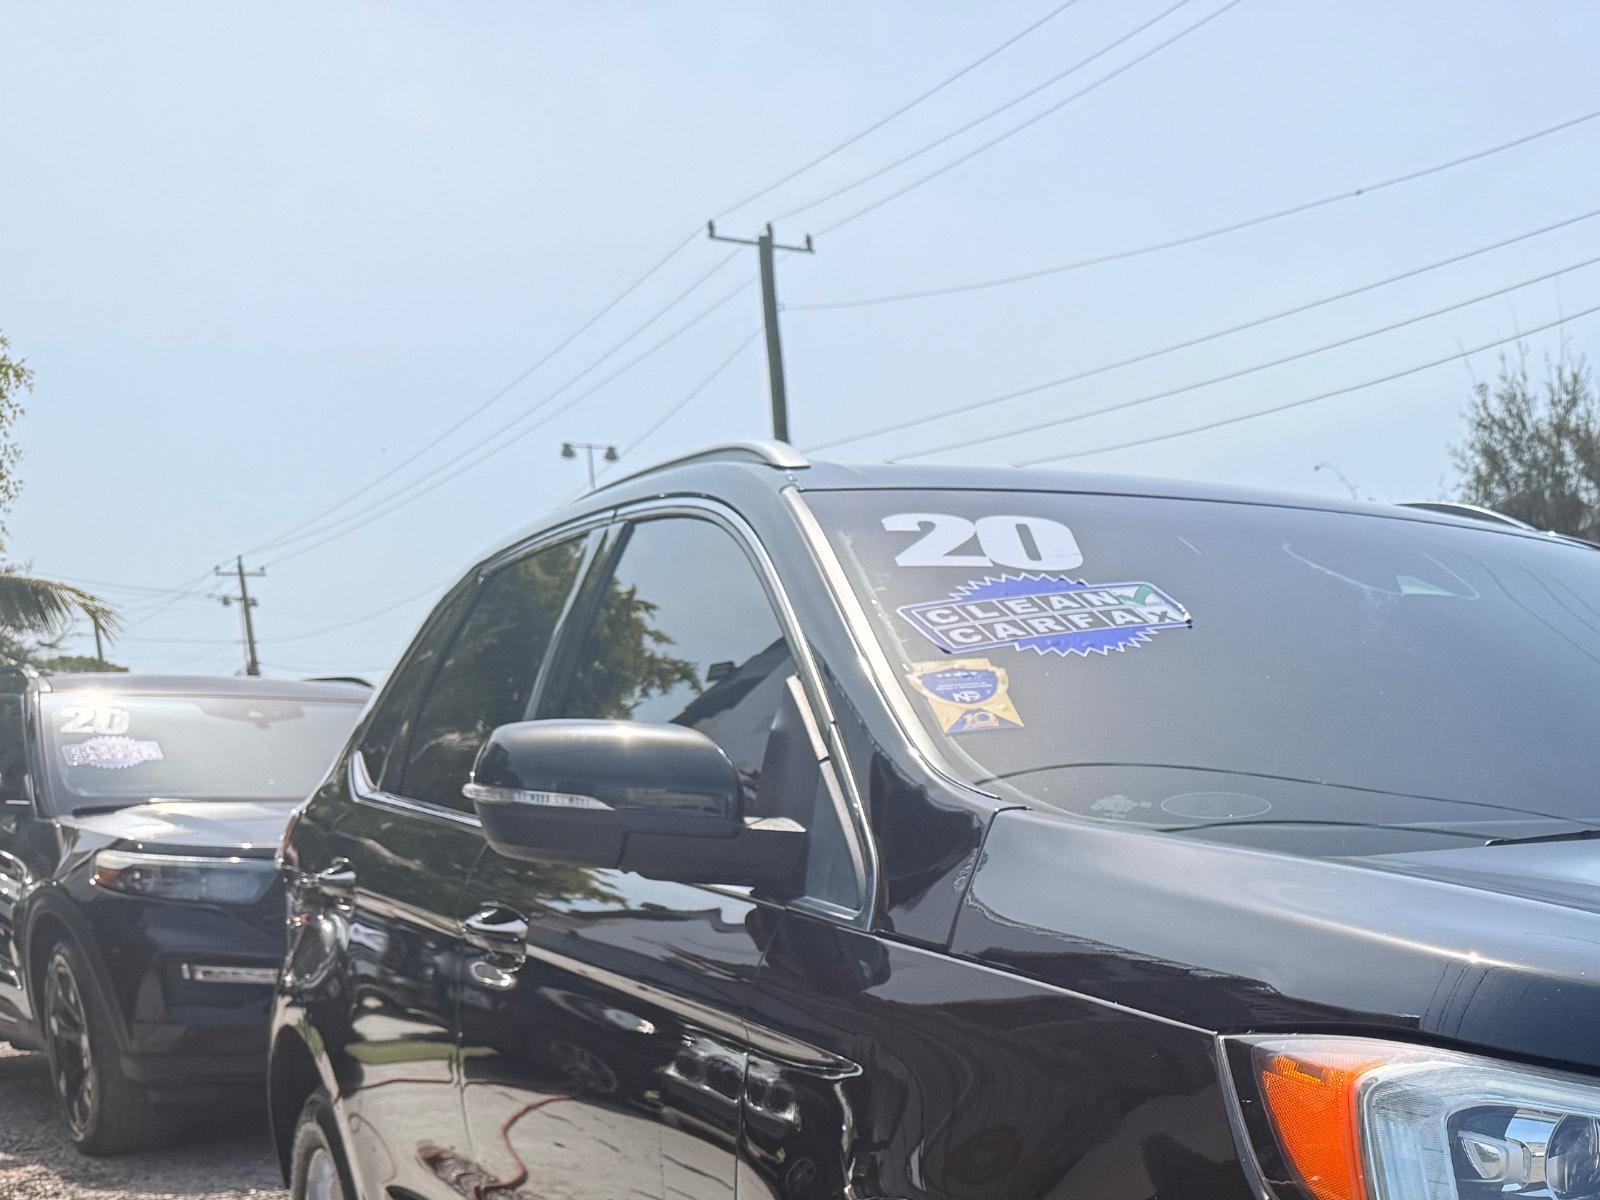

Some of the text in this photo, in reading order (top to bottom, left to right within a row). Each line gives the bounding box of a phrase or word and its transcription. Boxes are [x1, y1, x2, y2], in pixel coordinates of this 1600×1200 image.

[881, 512, 1083, 571] 20
[925, 589, 1123, 625] CLEAN
[948, 604, 1178, 646] CARFAX
[60, 705, 130, 735] 20
